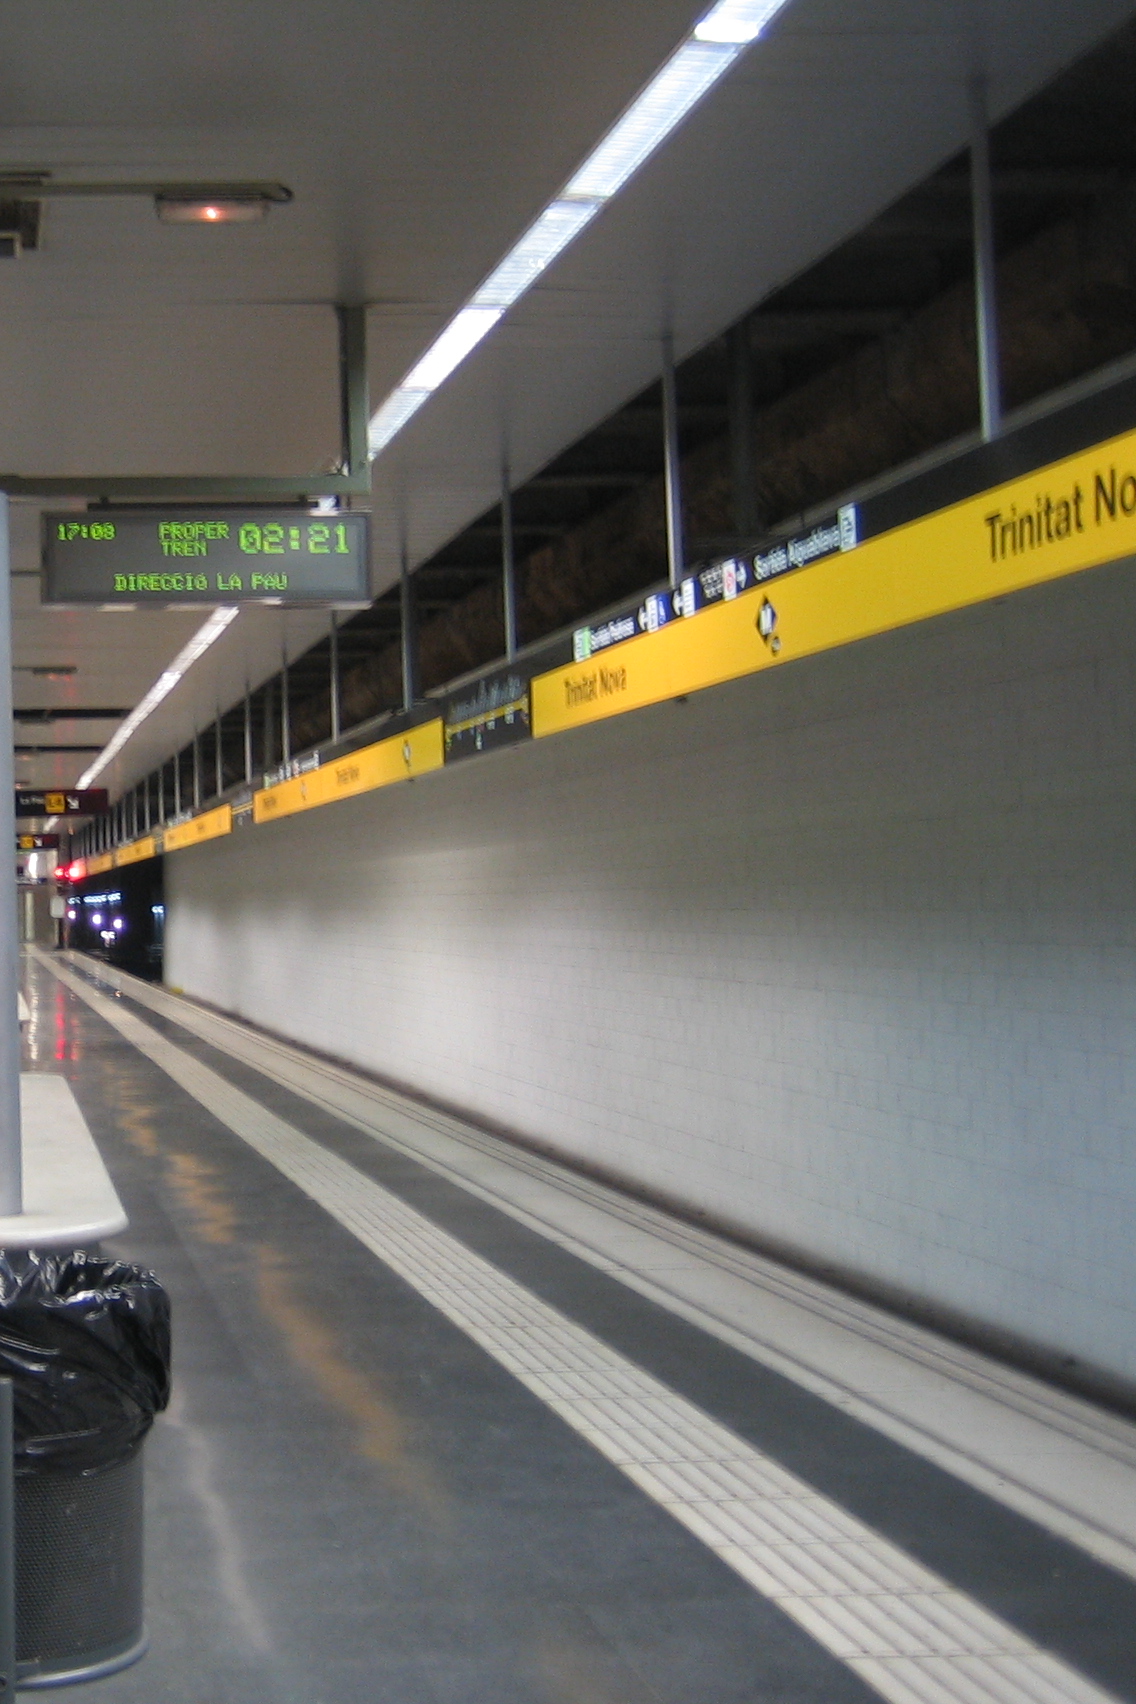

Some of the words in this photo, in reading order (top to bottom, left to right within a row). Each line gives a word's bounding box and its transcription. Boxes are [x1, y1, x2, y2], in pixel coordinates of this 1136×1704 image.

[58, 523, 116, 541] 17:08
[158, 522, 230, 539] PROPER
[985, 484, 1083, 563] Trinitat
[239, 522, 351, 554] 02:21
[161, 541, 208, 557] TREN
[216, 573, 243, 591] LA
[251, 573, 289, 591] PAU
[564, 671, 598, 708] Trinitat
[599, 663, 627, 698] Nova
